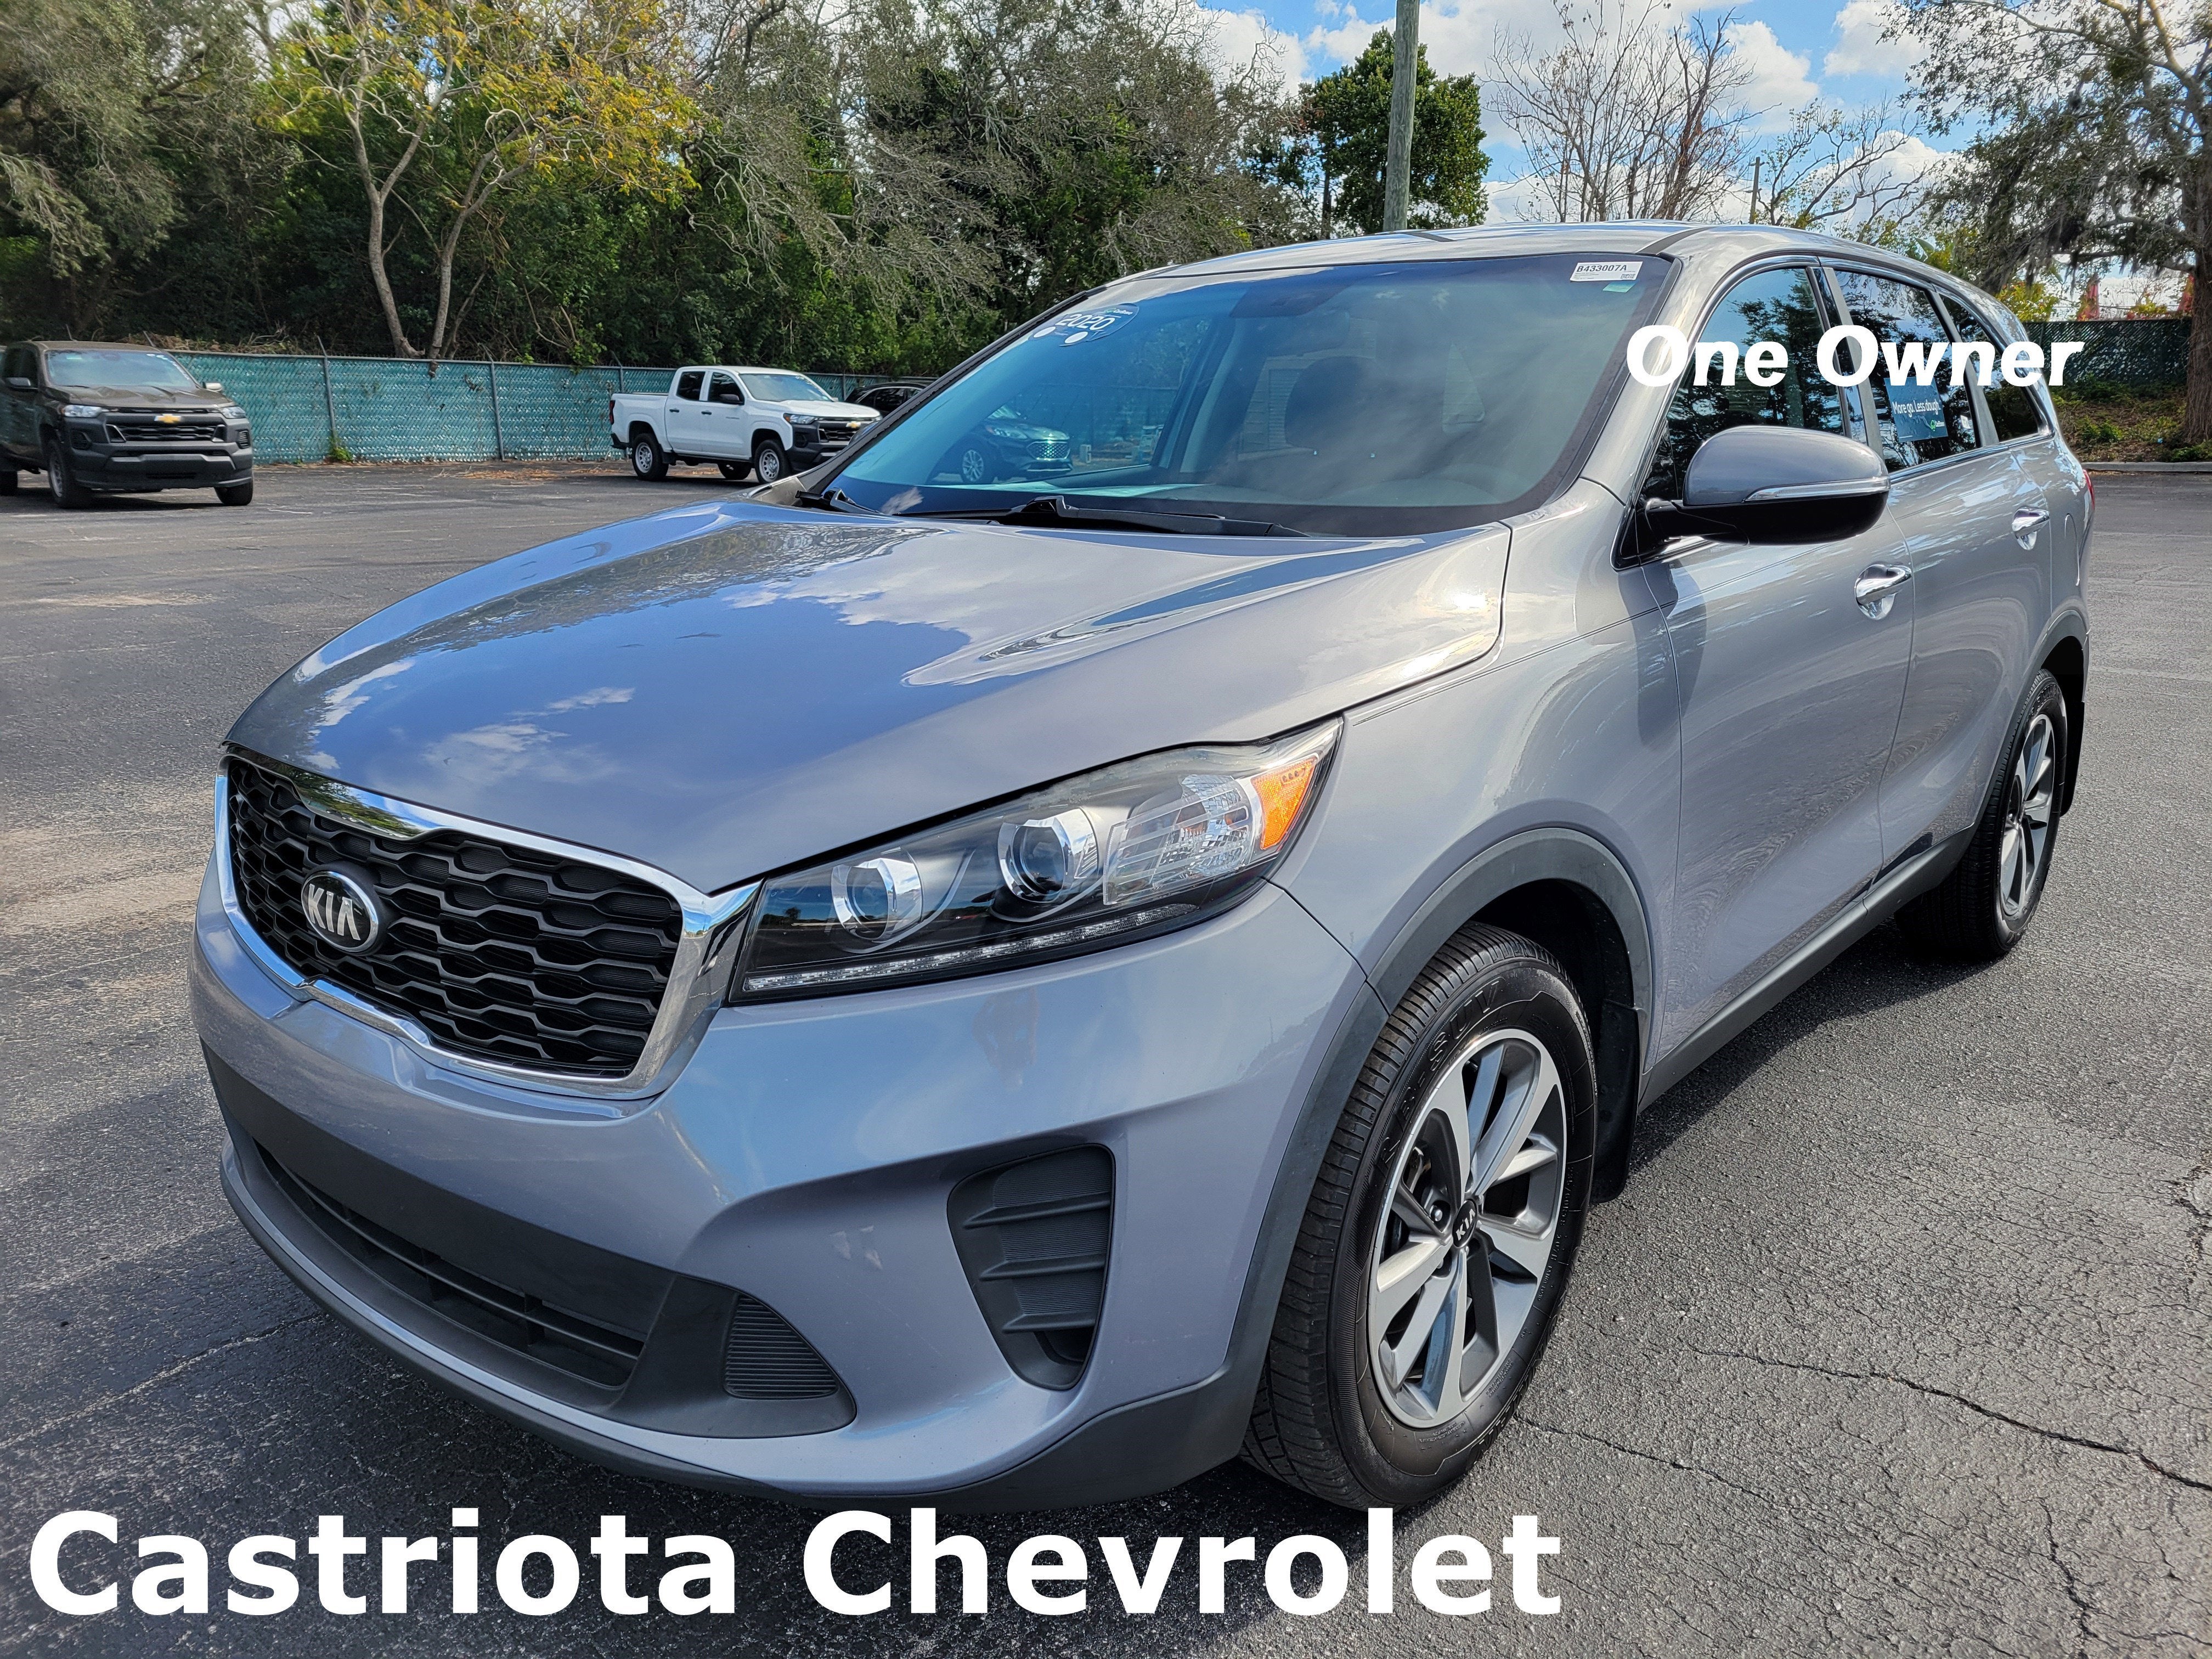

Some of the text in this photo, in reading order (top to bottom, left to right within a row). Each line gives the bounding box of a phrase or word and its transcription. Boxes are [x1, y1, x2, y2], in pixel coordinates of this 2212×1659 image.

[1576, 264, 1627, 273] B433007A
[1055, 313, 1115, 330] 2020
[1892, 398, 1941, 417] More go. Less dough.
[308, 883, 361, 941] KIA
[1455, 1208, 1476, 1241] KIA
